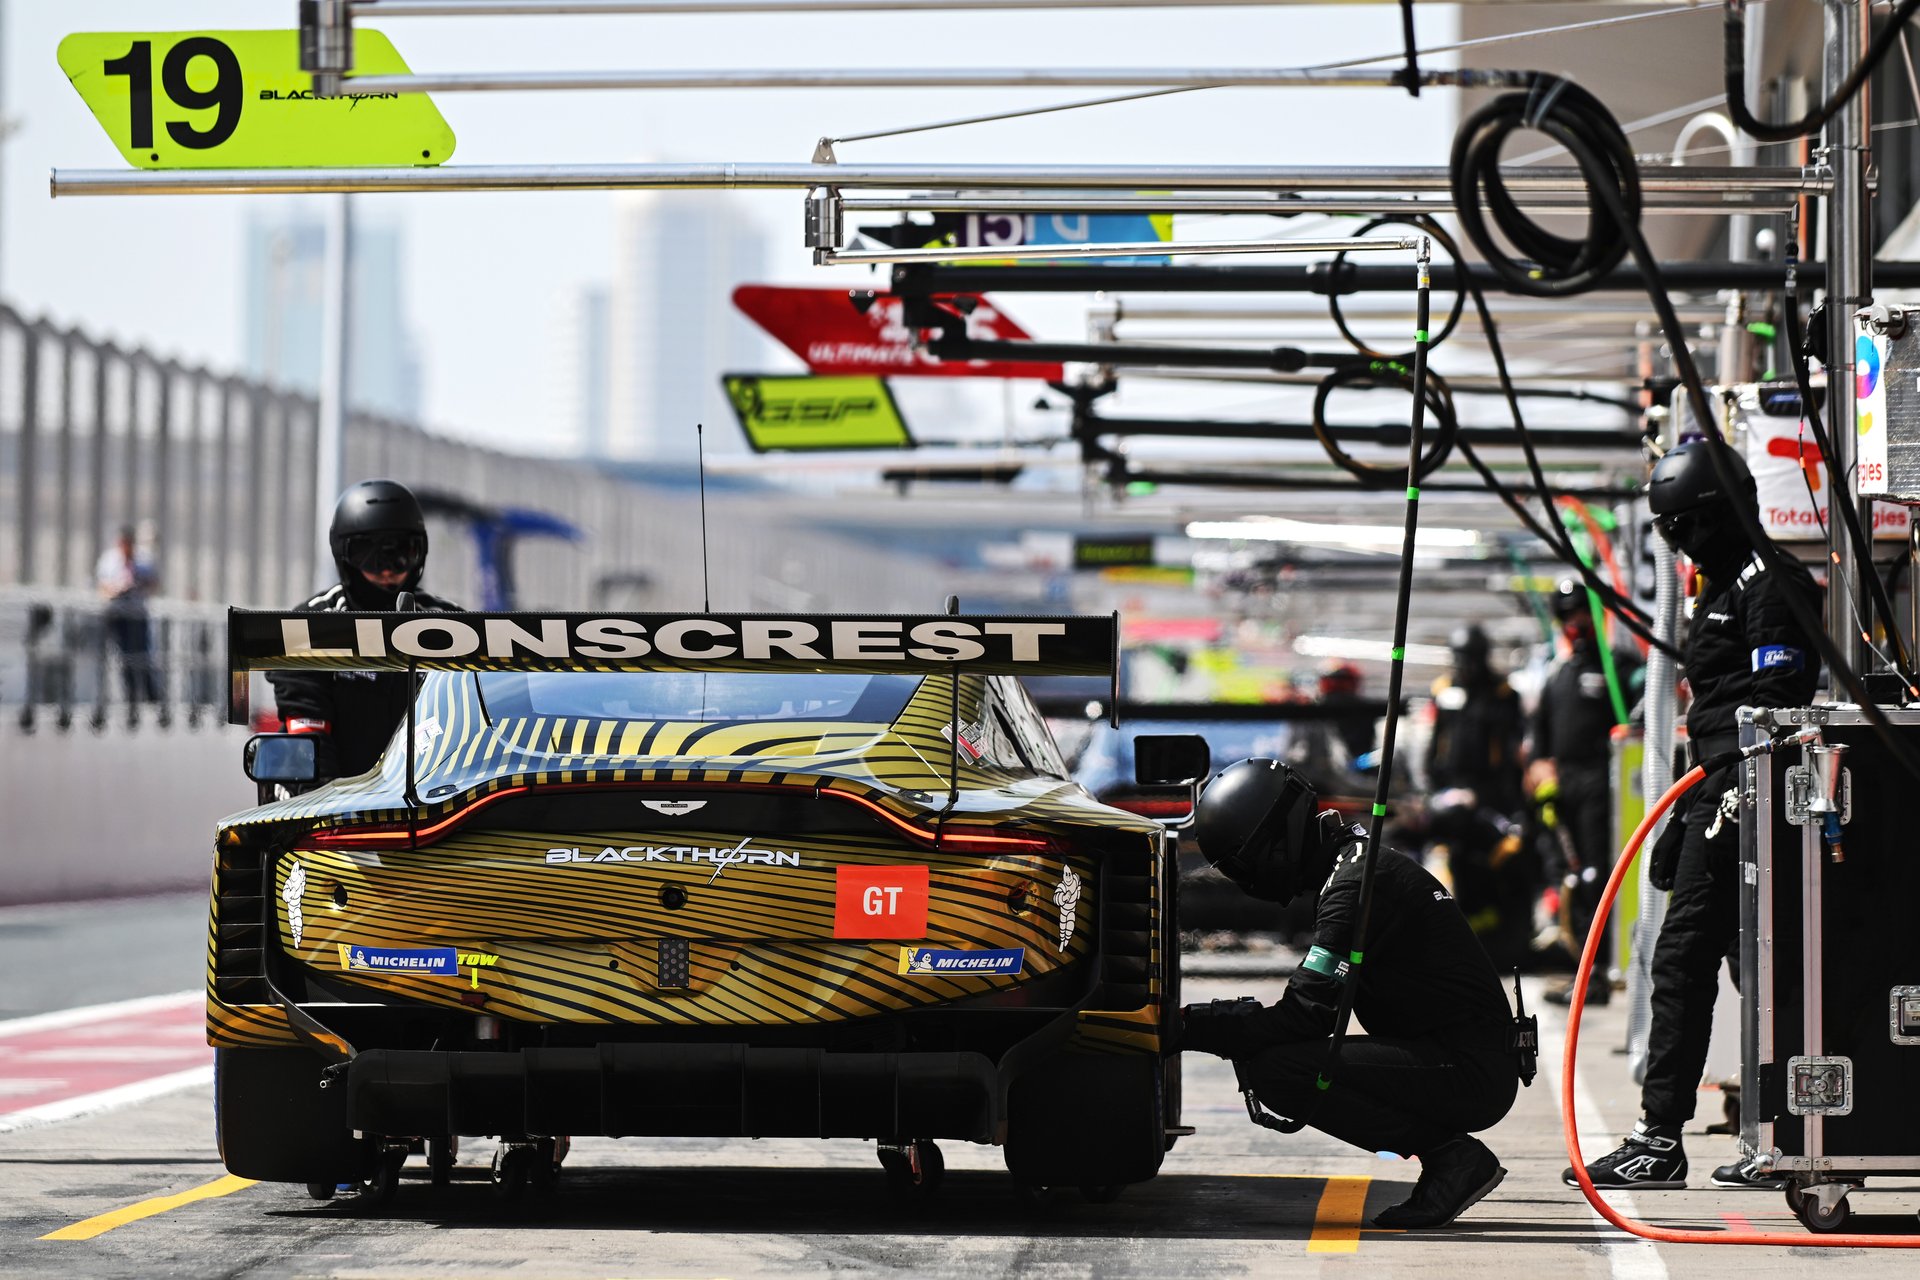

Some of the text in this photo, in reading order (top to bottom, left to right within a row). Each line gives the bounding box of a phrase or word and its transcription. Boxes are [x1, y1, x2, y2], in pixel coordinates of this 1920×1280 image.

[104, 36, 243, 149] 19
[280, 618, 1067, 662] LIONSCREST
[545, 843, 800, 874] BLACKTHORN
[863, 887, 903, 916] GT
[370, 956, 446, 968] MICHELIN
[457, 953, 499, 966] TOW
[936, 957, 1014, 969] MICHELIN
[1334, 968, 1347, 977] PIT
